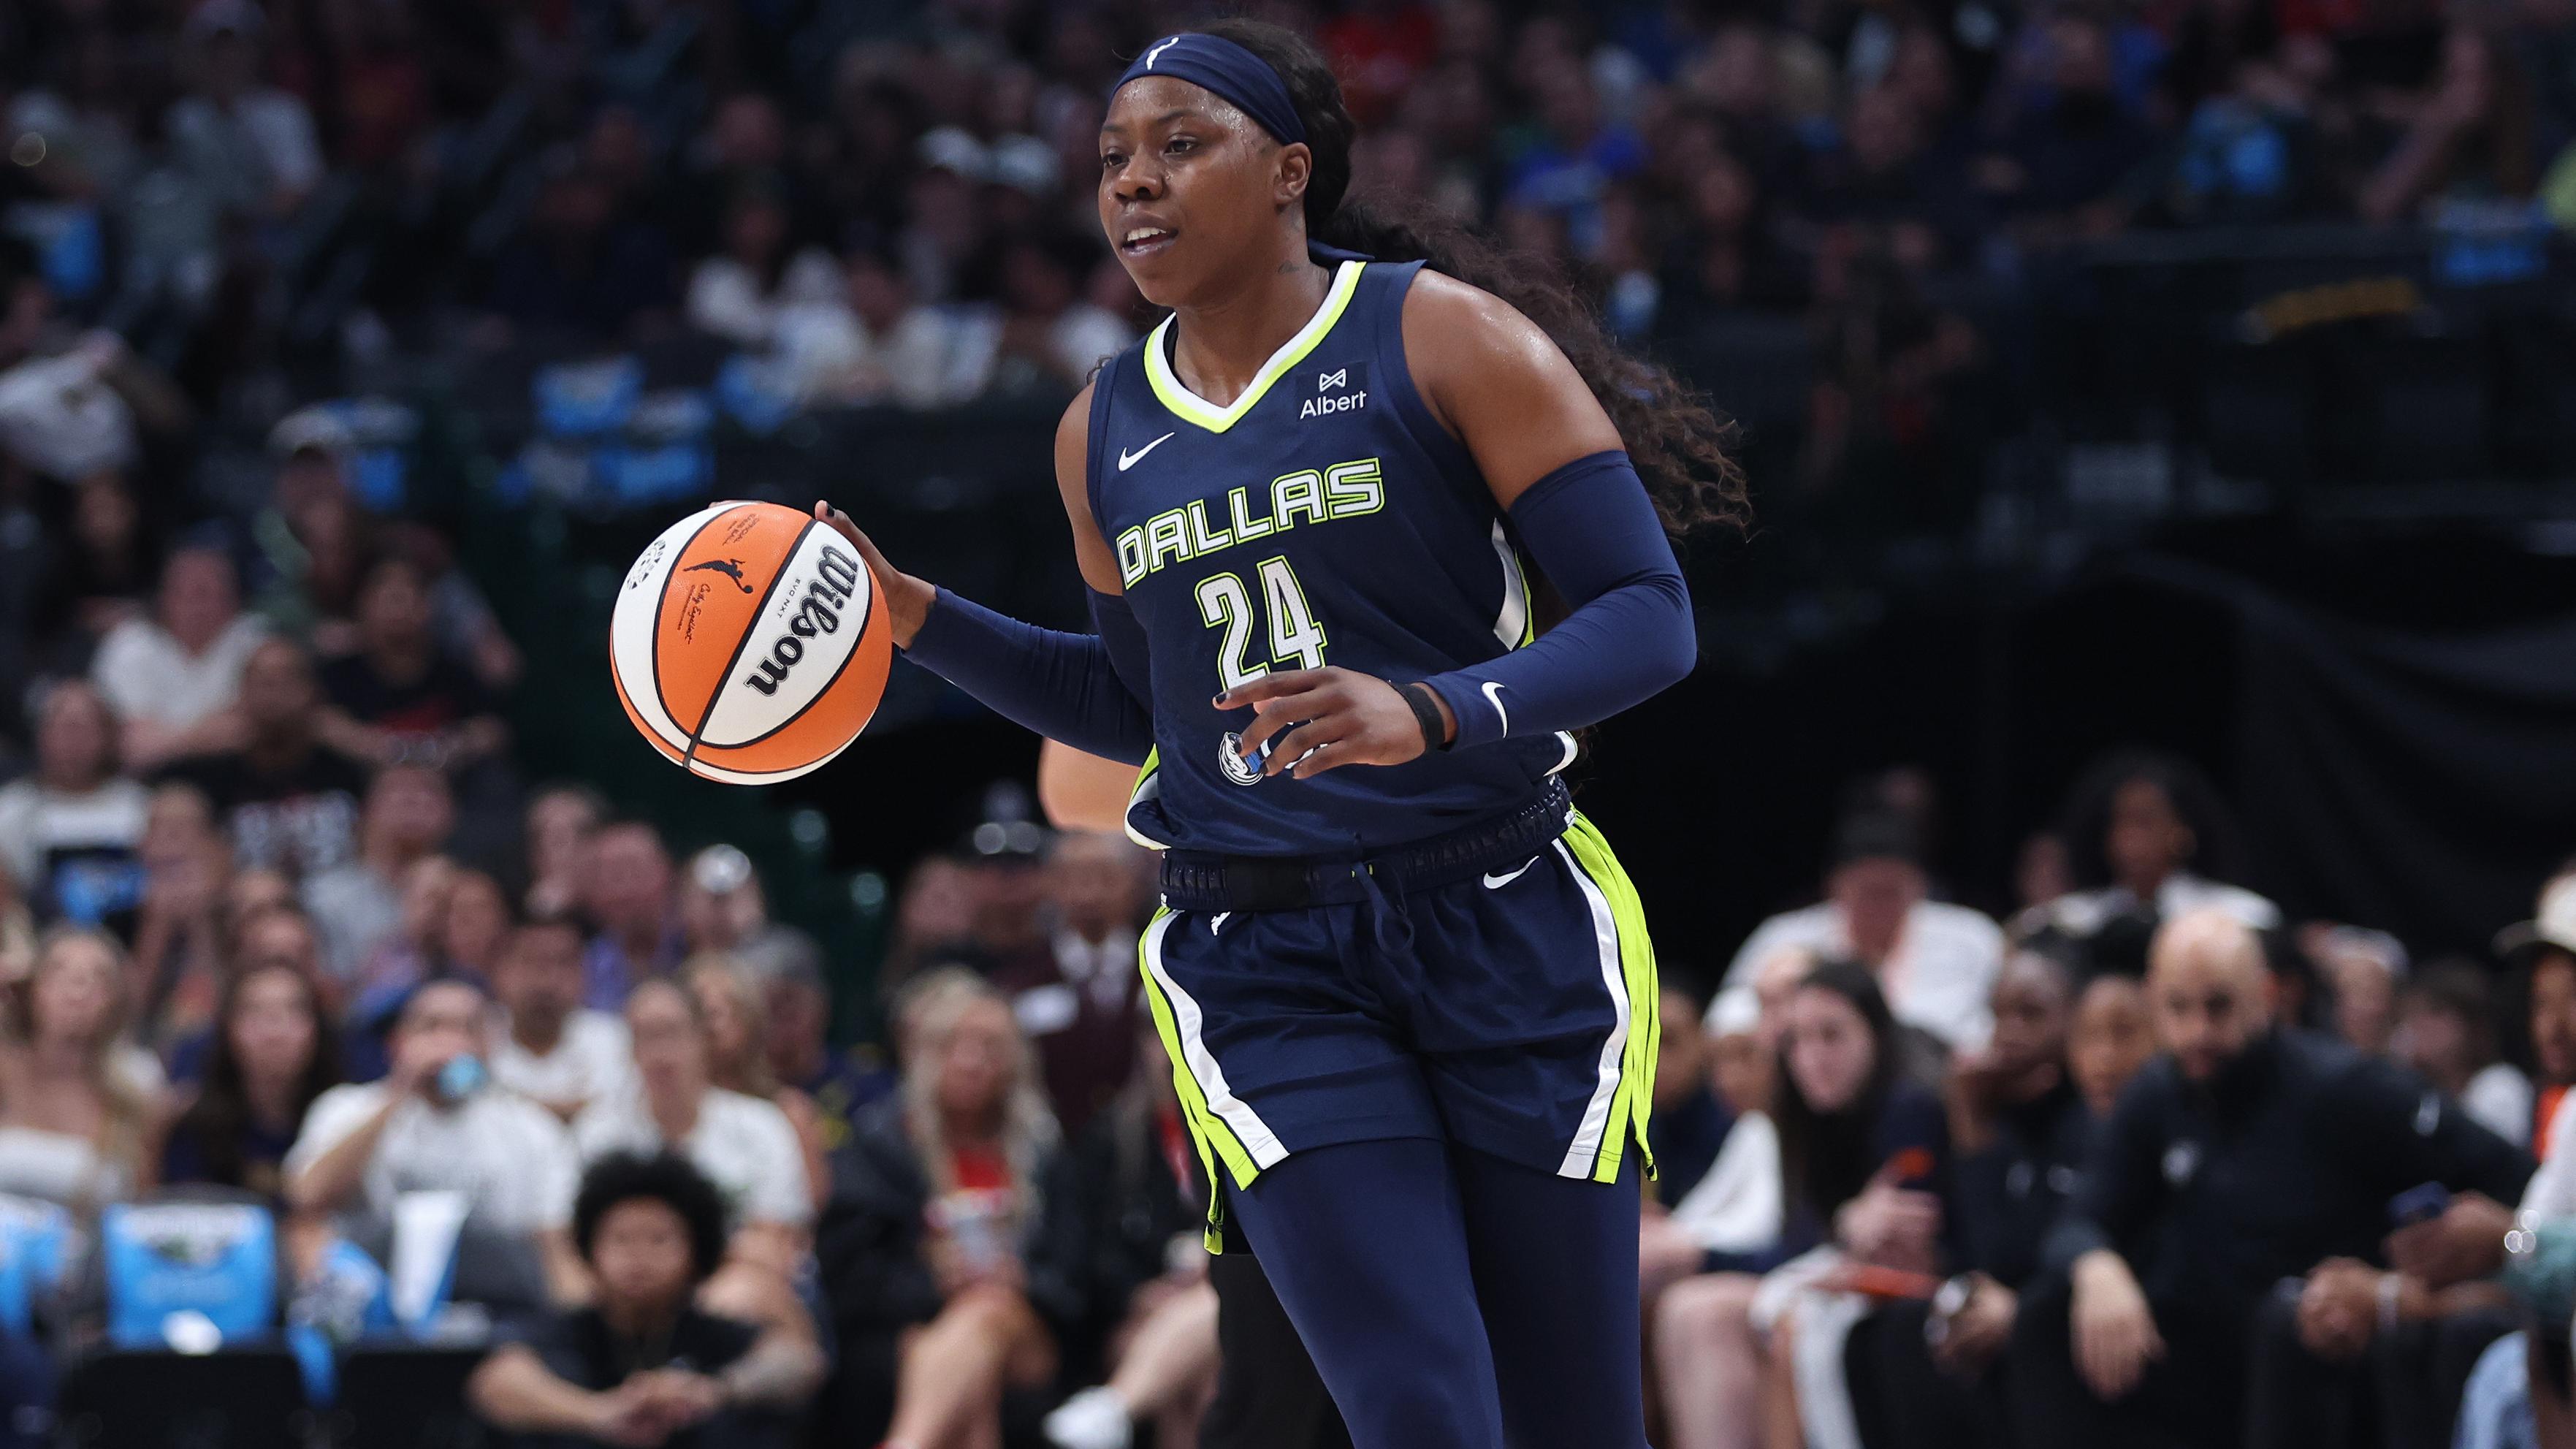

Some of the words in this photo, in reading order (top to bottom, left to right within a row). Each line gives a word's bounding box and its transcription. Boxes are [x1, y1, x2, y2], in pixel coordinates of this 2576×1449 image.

[1300, 389, 1367, 420] Albert
[1116, 457, 1385, 590] DALLAS
[743, 543, 860, 697] Wilson
[777, 598, 790, 618] NXT
[789, 578, 801, 597] EVO
[1194, 555, 1328, 692] 24
